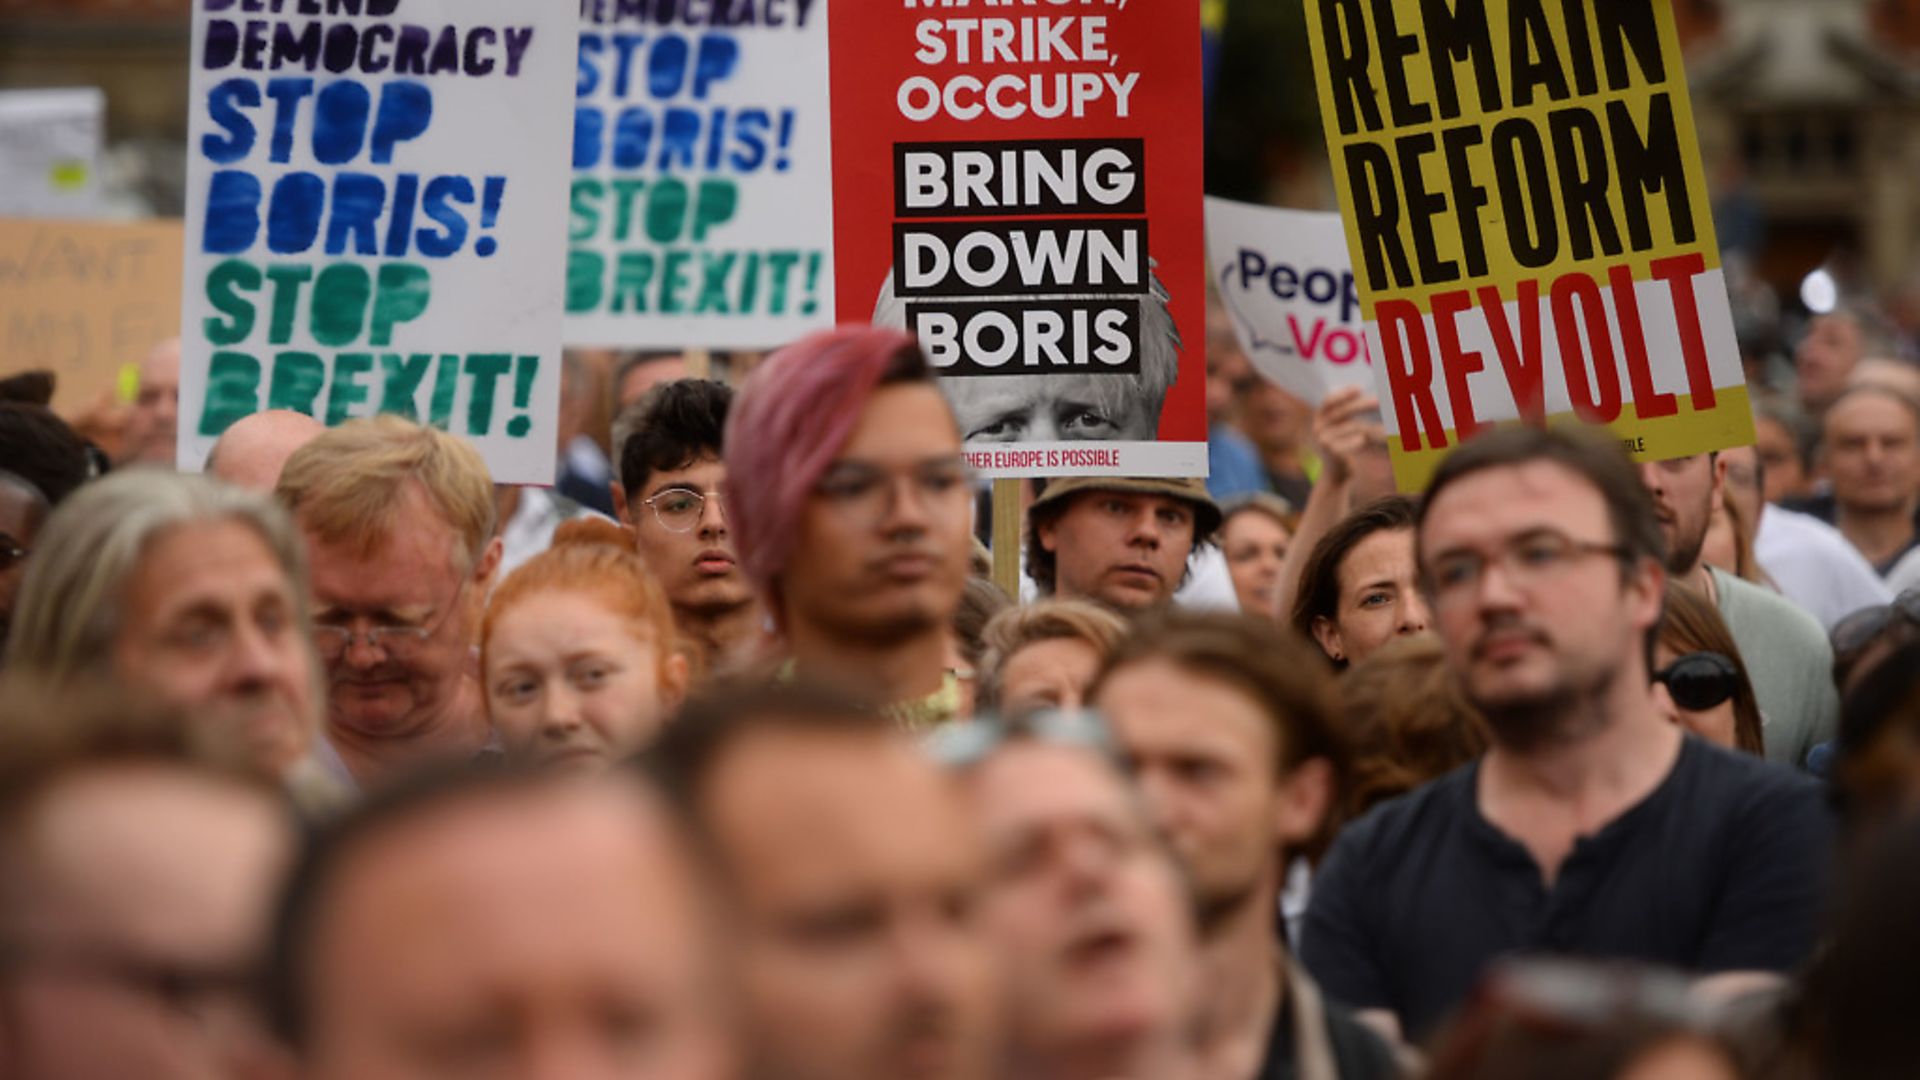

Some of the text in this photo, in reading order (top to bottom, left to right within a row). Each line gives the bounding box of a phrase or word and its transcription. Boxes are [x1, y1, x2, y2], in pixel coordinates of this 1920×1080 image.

[579, 0, 815, 28] EMOCRACY
[914, 16, 1118, 66] STRIKE,
[202, 20, 533, 76] DEMOCRACY
[576, 33, 739, 100] STOP
[1319, 0, 1666, 135] REMAIN
[202, 78, 432, 165] STOP
[897, 72, 1139, 121] OCCUPY
[572, 106, 794, 171] BORIS!
[905, 148, 1135, 208] BRING
[1343, 92, 1697, 291] REFORM
[202, 170, 507, 258] BORIS!
[568, 179, 738, 243] STOP
[564, 250, 822, 315] BREXIT!
[904, 230, 1138, 287] DOWN
[203, 260, 431, 347] STOP
[917, 309, 1132, 366] BORIS
[1286, 313, 1371, 367] Vo
[1374, 252, 1717, 452] REVOLT
[197, 351, 539, 438] BREXIT!
[994, 450, 1043, 468] EUROPE
[1047, 450, 1059, 467] IS
[1061, 449, 1120, 467] POSSIBLE
